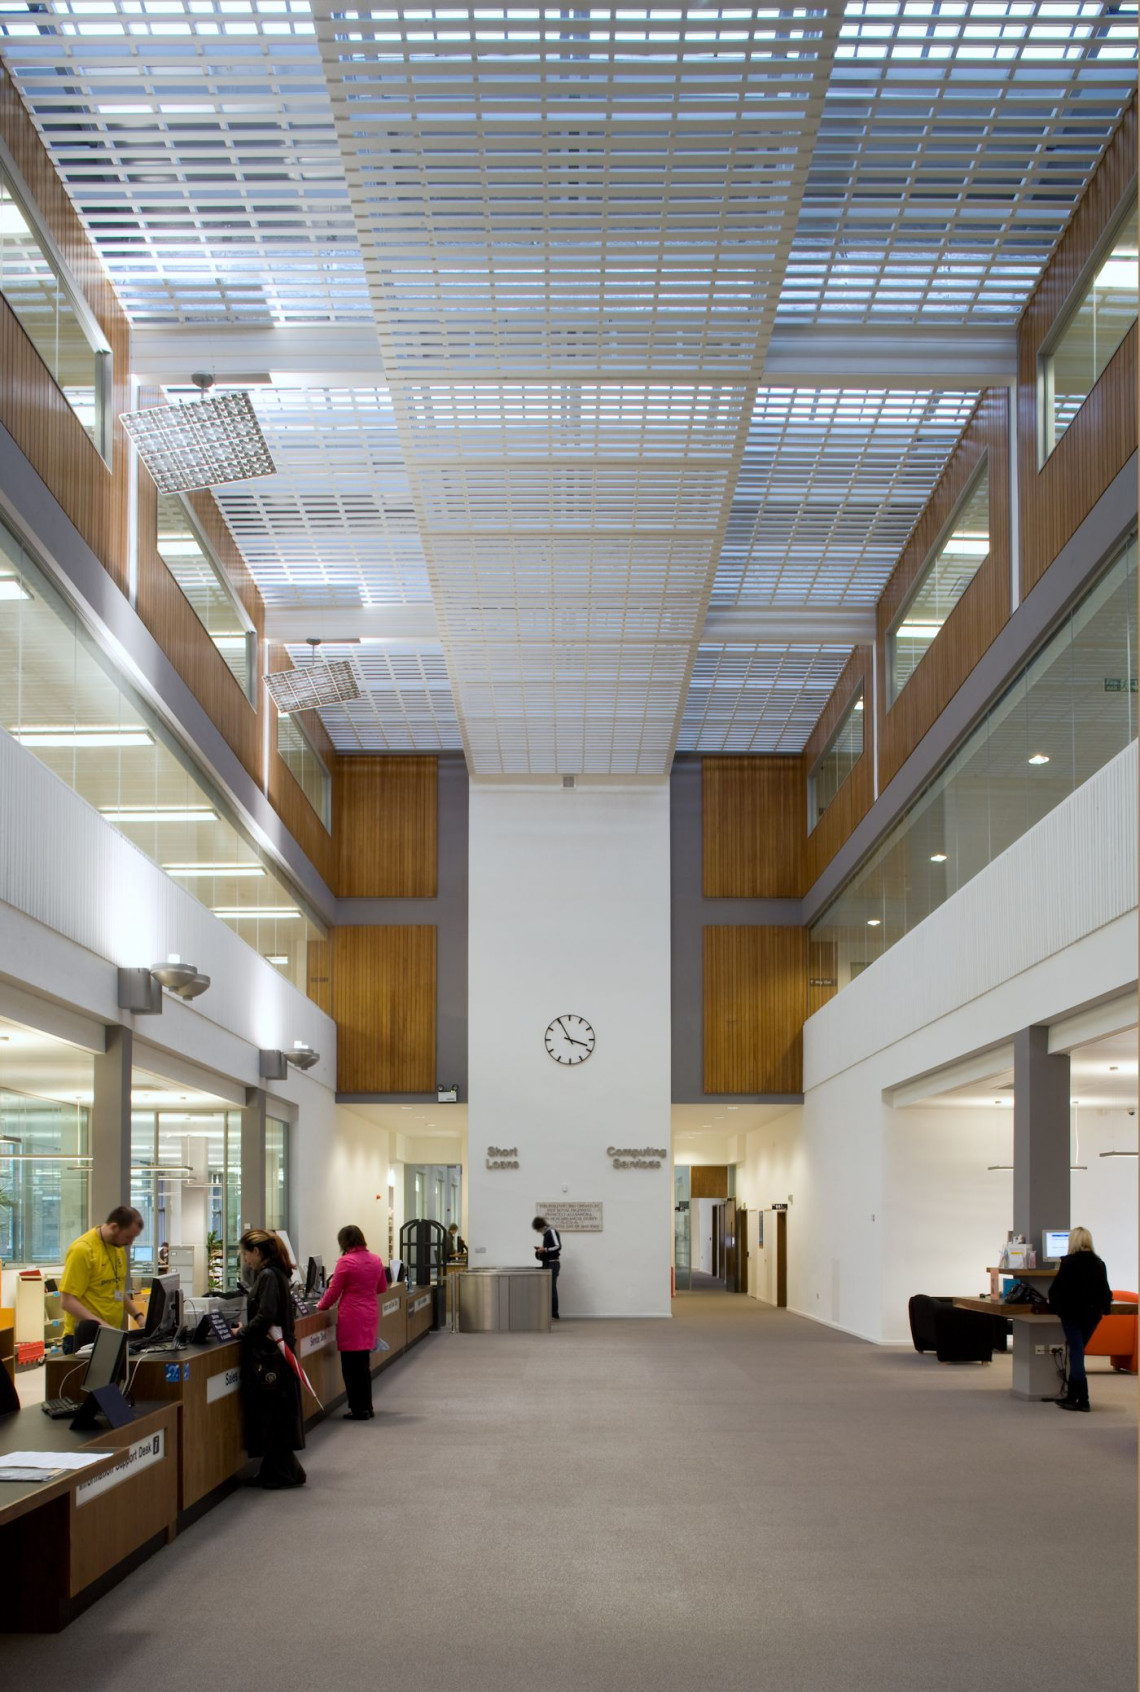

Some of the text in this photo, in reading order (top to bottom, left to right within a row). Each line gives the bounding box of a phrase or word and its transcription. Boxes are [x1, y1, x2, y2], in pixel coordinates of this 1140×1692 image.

[487, 1146, 518, 1157] Short
[606, 1146, 667, 1159] Computing
[485, 1158, 520, 1170] Loans
[612, 1158, 661, 1169] Services
[138, 1441, 152, 1458] Desk
